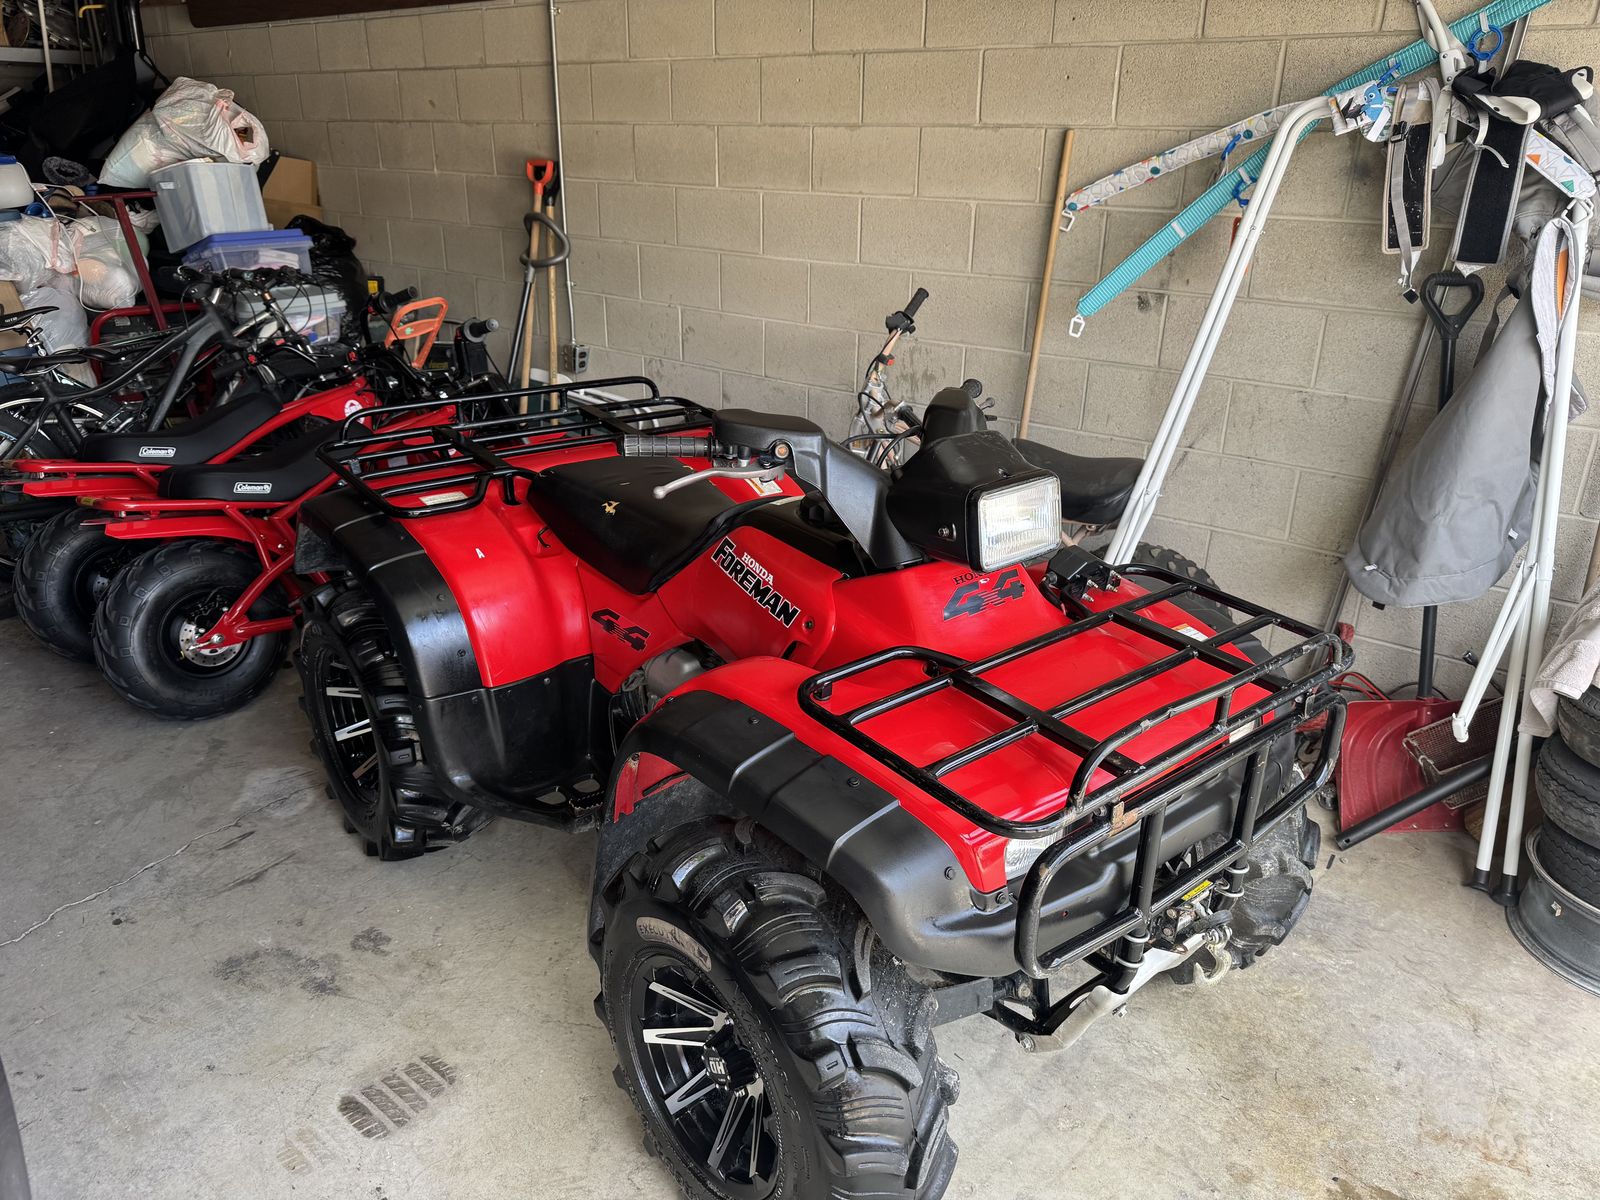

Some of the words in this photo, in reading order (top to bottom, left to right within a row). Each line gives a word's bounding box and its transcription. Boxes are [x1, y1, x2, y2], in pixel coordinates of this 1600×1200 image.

[142, 447, 170, 456] Coleman
[236, 483, 266, 492] Coleman
[741, 551, 774, 586] HONDA
[709, 1060, 726, 1075] HD
